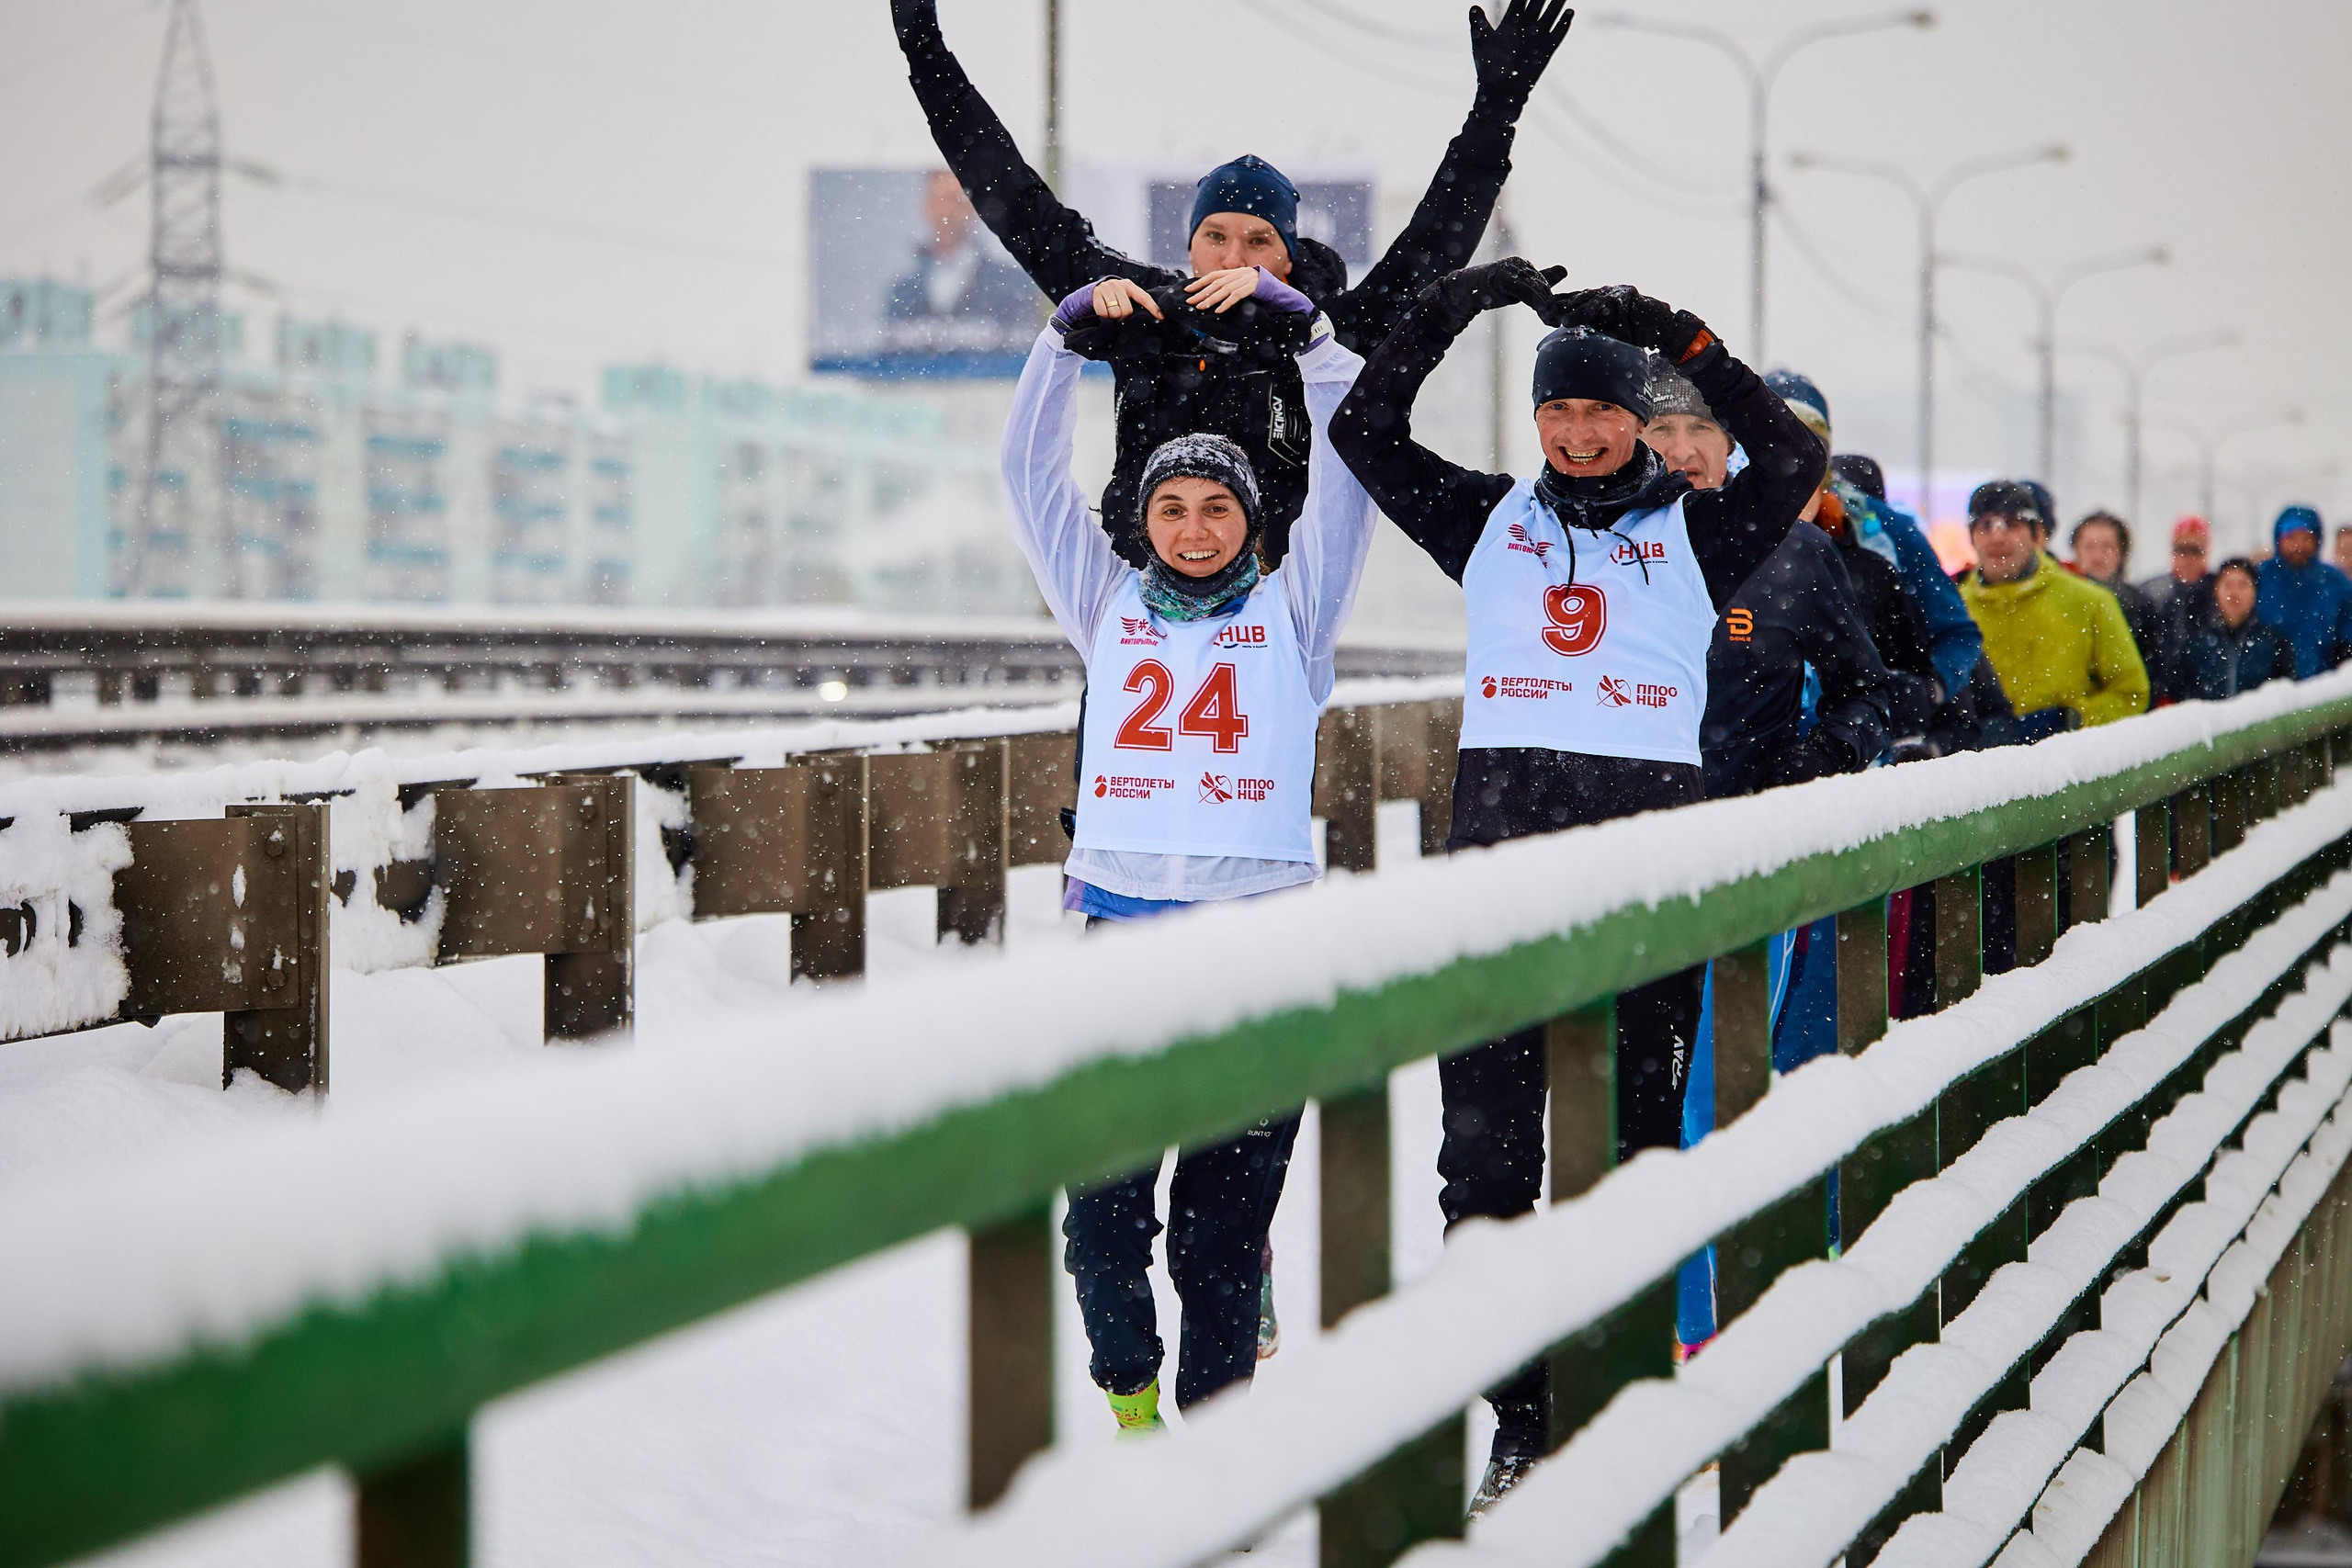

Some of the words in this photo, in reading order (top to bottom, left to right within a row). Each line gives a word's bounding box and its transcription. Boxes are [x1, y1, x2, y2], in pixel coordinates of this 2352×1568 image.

[1618, 541, 1665, 558] НЦВ
[1542, 583, 1607, 657] 9
[1219, 626, 1265, 643] НЦВ
[1501, 677, 1572, 692] ВЕРТОЛЕТЫ
[1636, 684, 1678, 697] ППОО
[1500, 688, 1548, 700] РОССИИ
[1114, 658, 1249, 753] 24
[1636, 695, 1668, 707] НЦВ
[1110, 776, 1174, 790] ВЕРТОЛЕТЫ
[1238, 778, 1274, 791] ППОО
[1109, 788, 1150, 799] РОССИИ
[1238, 790, 1266, 802] НЦВ
